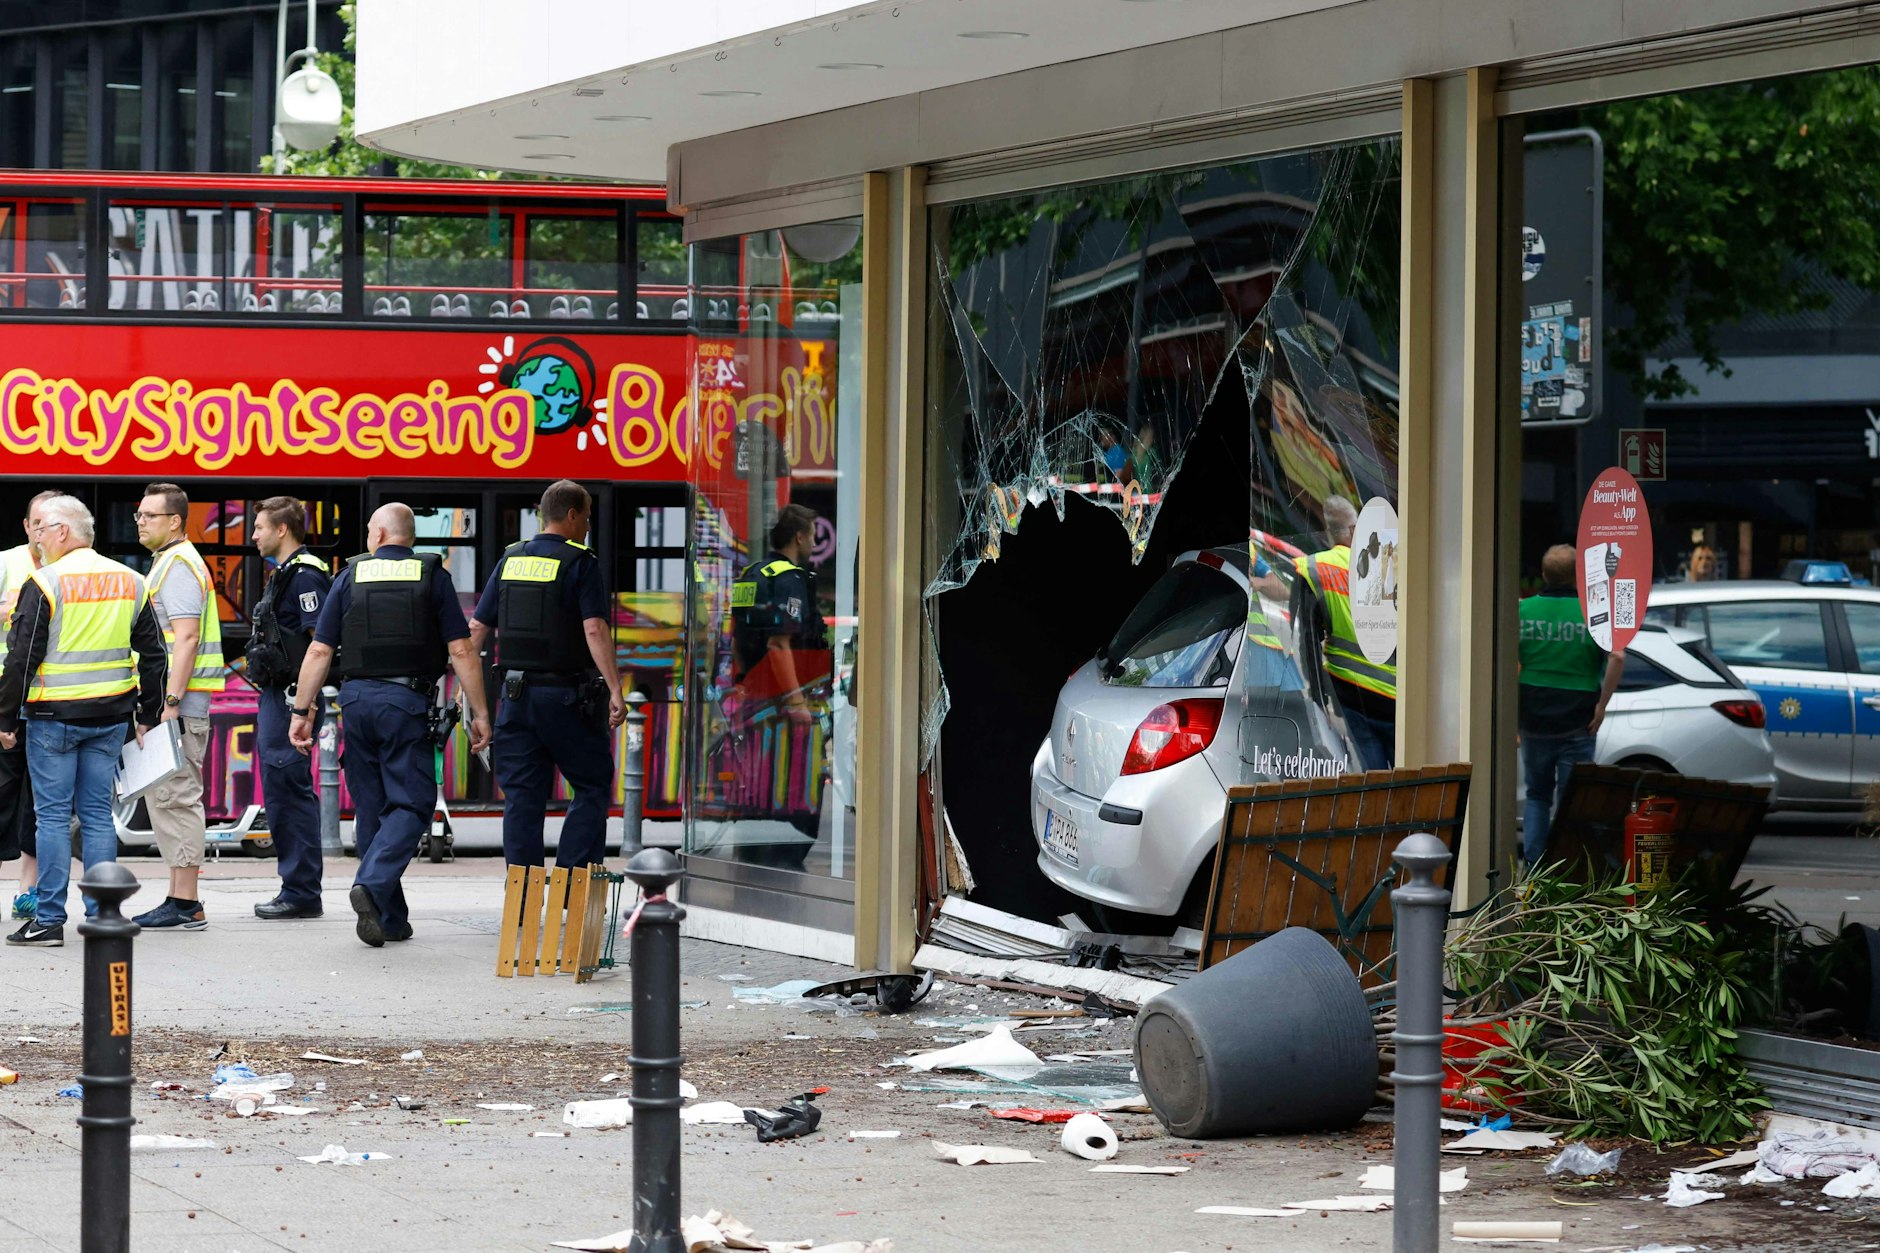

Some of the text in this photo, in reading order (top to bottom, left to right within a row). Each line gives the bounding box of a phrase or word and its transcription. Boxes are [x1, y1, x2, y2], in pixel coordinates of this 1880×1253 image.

[0, 367, 536, 470] CitySightseeing
[1593, 487, 1637, 507] Beauty-Welt
[1621, 505, 1637, 522] App
[359, 559, 418, 578] POLIZEI
[506, 559, 556, 579] POLIZEI
[1253, 745, 1348, 779] Let's celebrate!
[112, 965, 126, 1022] ULTRAS
